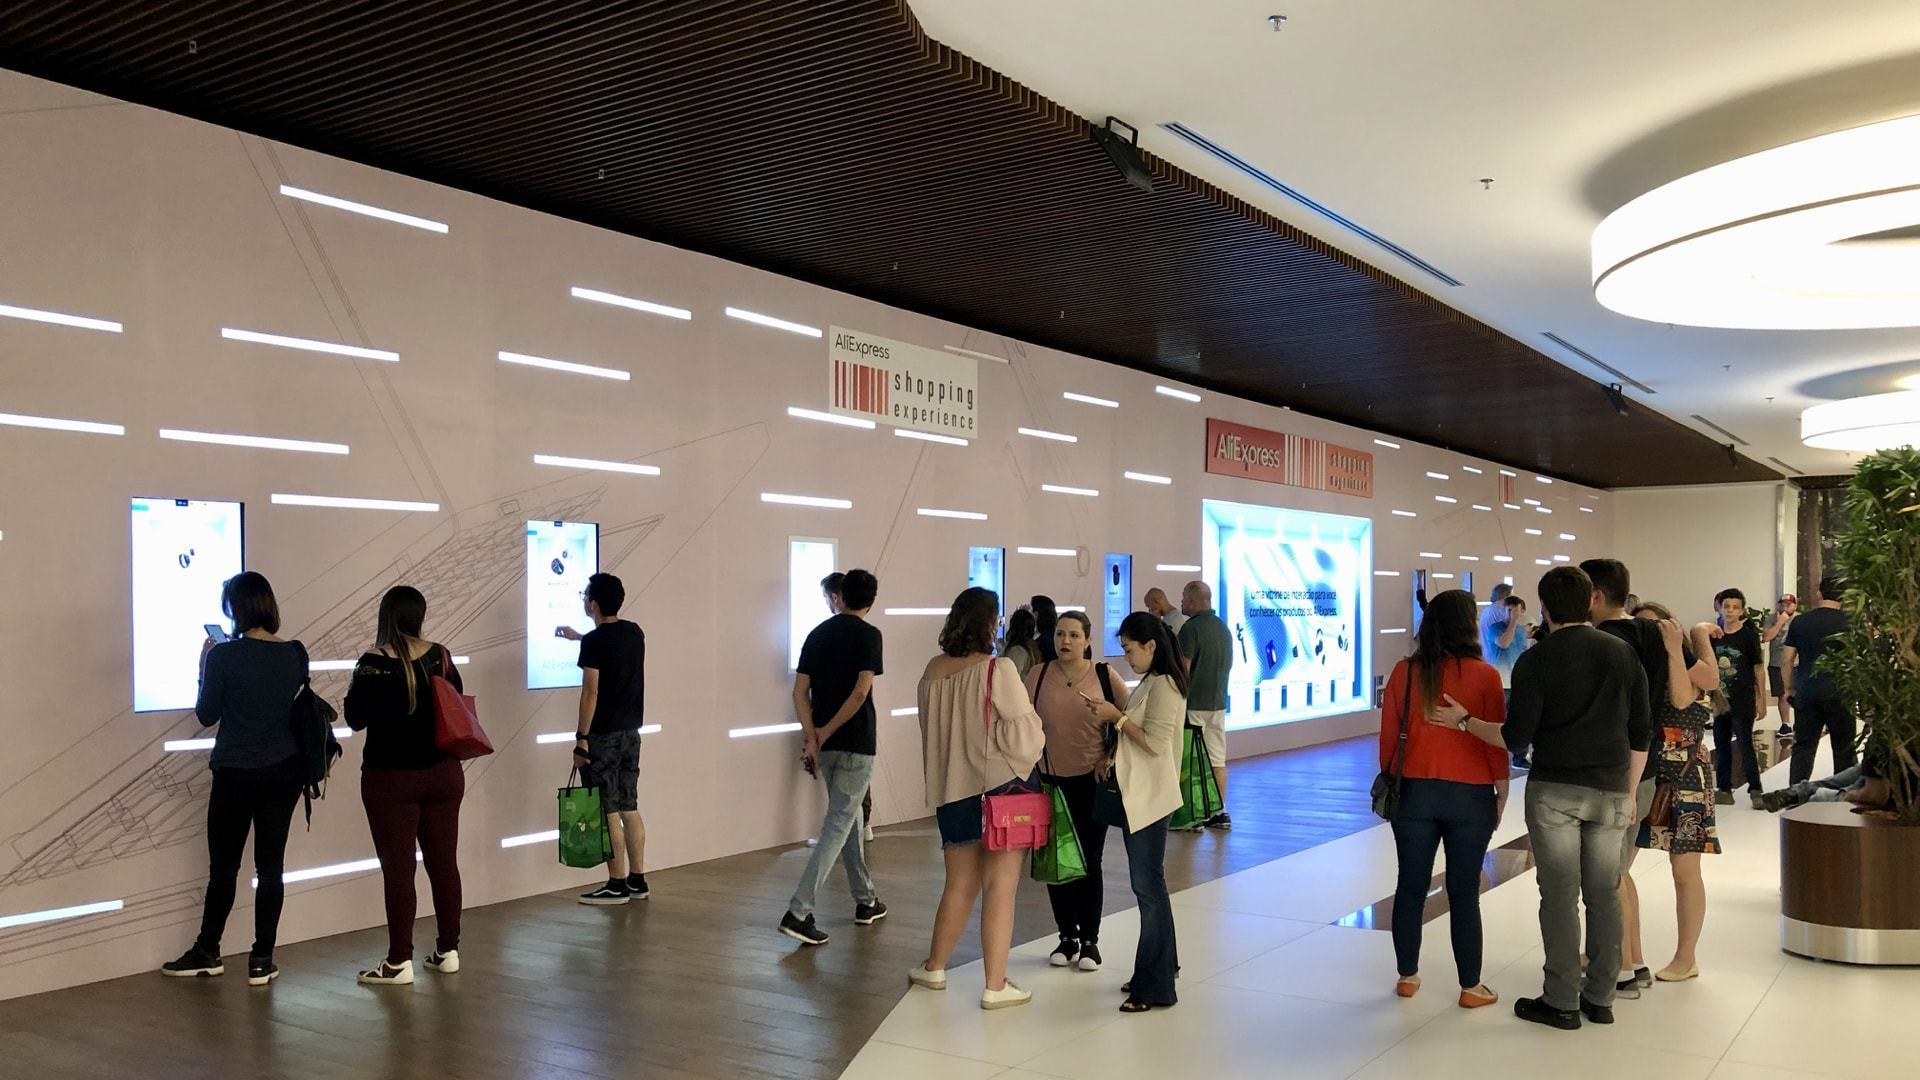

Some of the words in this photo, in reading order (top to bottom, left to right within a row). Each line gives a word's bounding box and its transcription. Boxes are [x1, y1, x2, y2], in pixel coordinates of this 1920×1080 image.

[835, 333, 890, 360] AliExpress
[894, 370, 974, 410] shopping
[894, 402, 973, 431] experience
[1216, 433, 1280, 471] AliExpress
[1330, 451, 1369, 476] shopping
